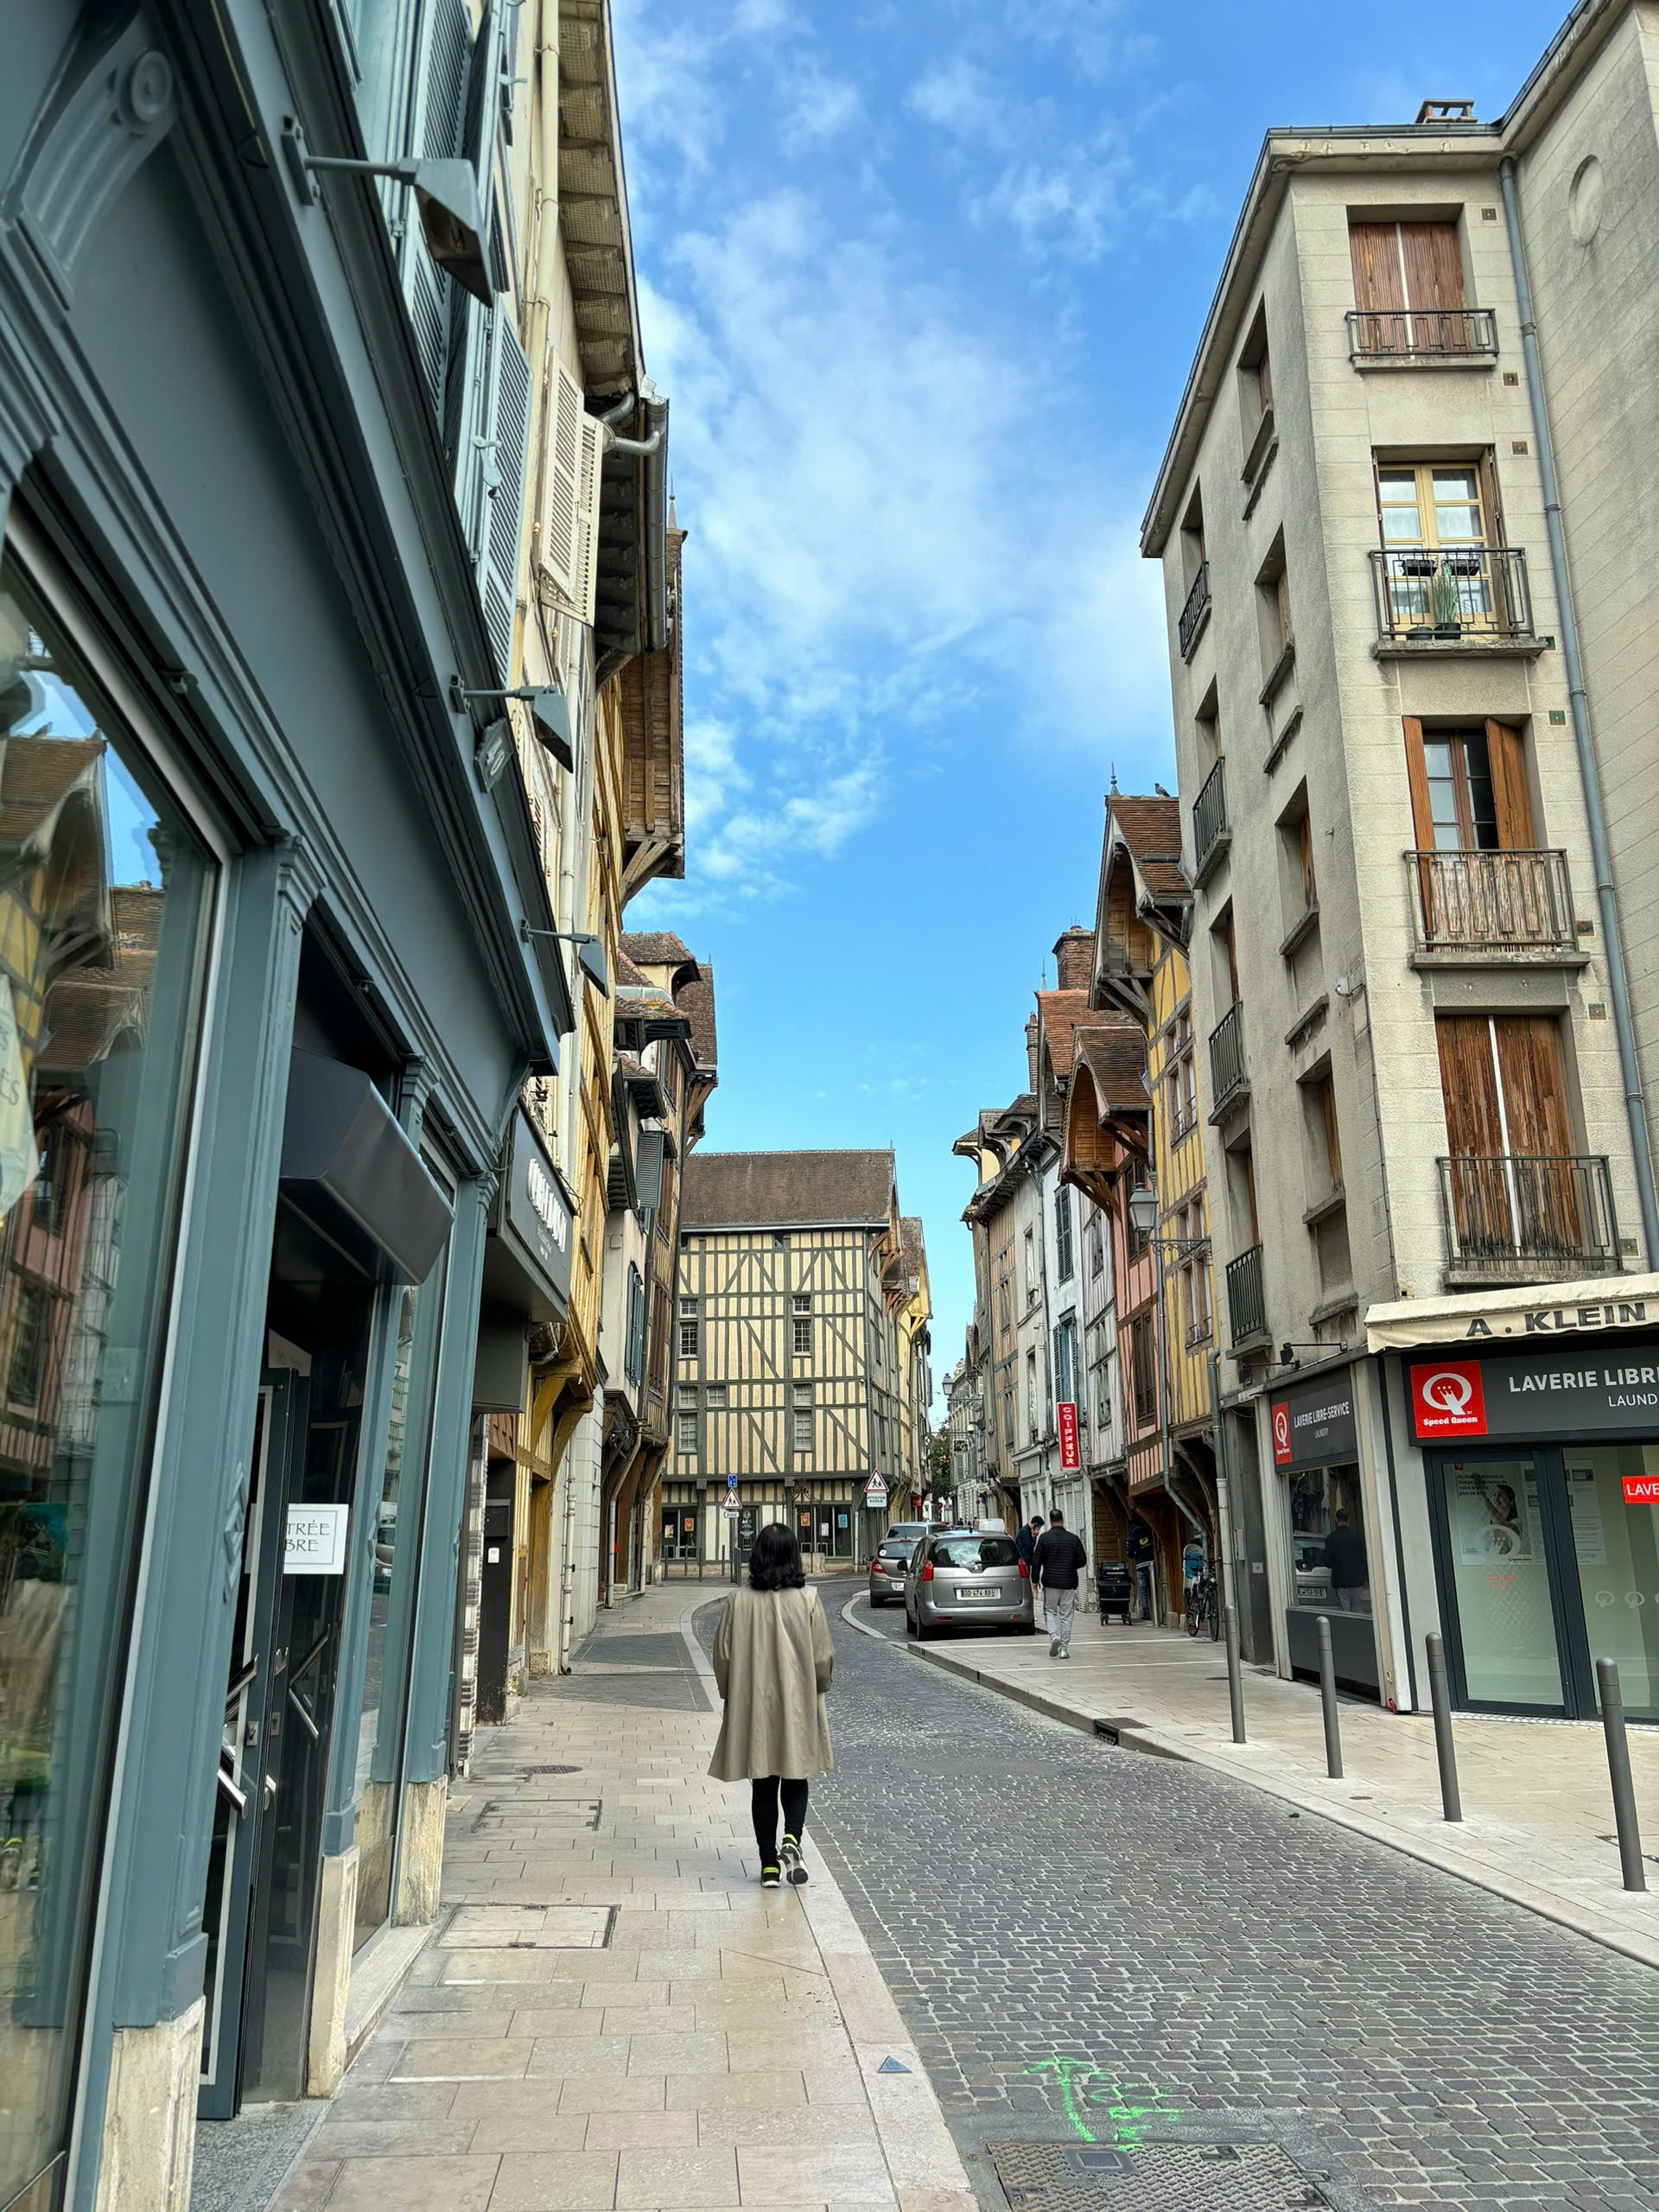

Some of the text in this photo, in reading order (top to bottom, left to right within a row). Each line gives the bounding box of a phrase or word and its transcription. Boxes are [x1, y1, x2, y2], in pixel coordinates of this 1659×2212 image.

[1524, 1302, 1646, 1332] KLEIN
[1509, 1366, 1659, 1392] LAVERIE LIBR
[1294, 1402, 1350, 1427] LAVERIE LIBRE-SERVICE
[1423, 1417, 1449, 1427] Speed
[1063, 1407, 1075, 1465] COIFFEUR
[285, 1539, 319, 1552] BRE
